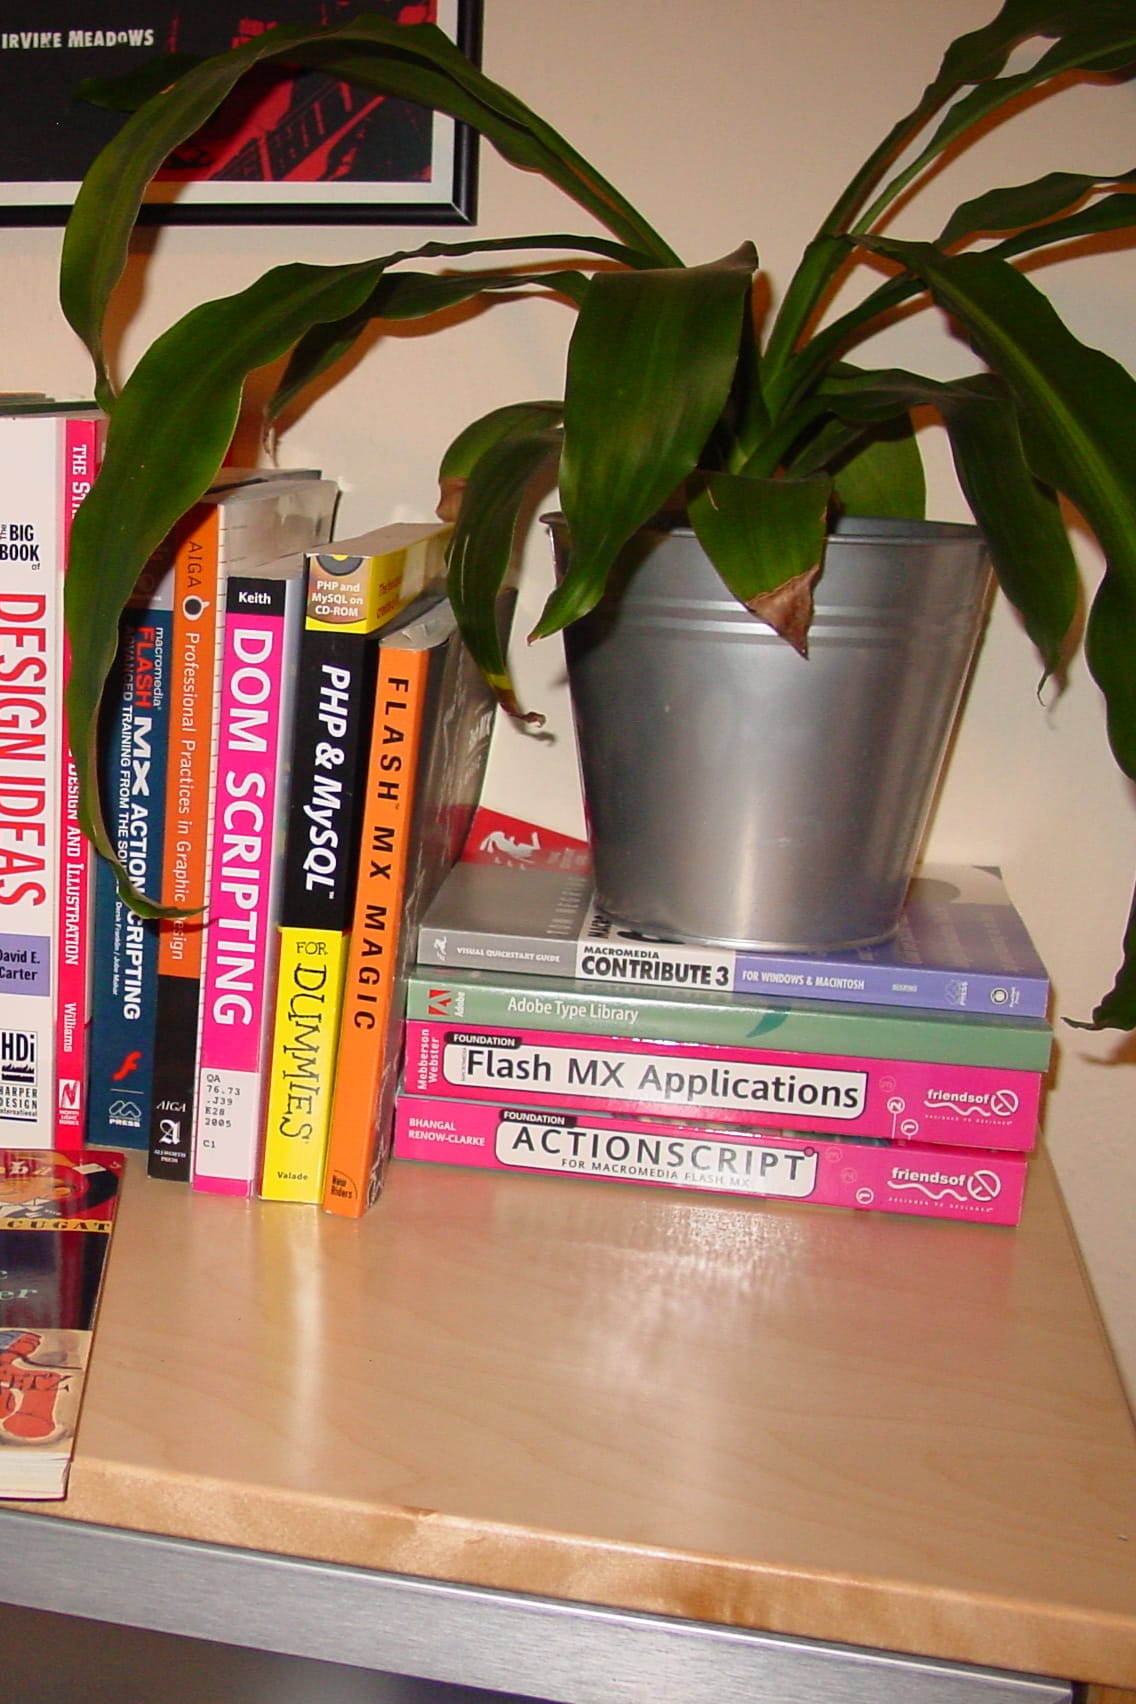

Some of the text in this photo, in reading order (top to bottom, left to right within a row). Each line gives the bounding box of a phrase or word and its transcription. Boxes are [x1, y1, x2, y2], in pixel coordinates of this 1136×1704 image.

[1, 32, 62, 49] IRVINE
[71, 444, 87, 475] THE
[0, 523, 8, 541] The
[9, 523, 35, 542] BIG
[0, 543, 40, 562] BOOK
[31, 562, 41, 571] of
[316, 580, 360, 593] PHP and
[238, 590, 271, 606] Keith
[312, 593, 364, 605] MySQL on
[315, 605, 359, 617] CD-ROM
[152, 627, 164, 707] macromedia
[119, 705, 133, 767] TRAINING
[169, 541, 202, 961] AIGA Professional Practices in Graphic esign
[302, 664, 351, 893] PHP & MySQL
[119, 769, 132, 808] FROM
[117, 811, 130, 839] THE
[123, 626, 155, 1020] FLASH MX ACTIONCRIPTING
[214, 628, 273, 1027] DOM SCRIPTING
[67, 825, 81, 857] AND
[354, 677, 409, 1031] FLASH MX MAGIC
[30, 951, 40, 964] E.
[296, 941, 328, 956] FOR
[583, 945, 660, 960] MACROMEDIA
[581, 957, 730, 987] CONTRIBUTE 3
[742, 970, 865, 990] FOR WINDOWS & MACINTOSH
[507, 997, 639, 1023] Adobe Type Library
[63, 1002, 77, 1053] Williams
[1, 1031, 35, 1062] HDi
[453, 1033, 516, 1047] FOUNDATION
[279, 962, 328, 1143] DUMMIES
[417, 1028, 430, 1091] Mebberson
[428, 1038, 440, 1084] Webster
[206, 1074, 221, 1083] QA
[467, 1049, 552, 1082] Flash
[567, 1057, 625, 1088] MX
[638, 1063, 859, 1110] Applications
[206, 1085, 241, 1096] 76.73
[927, 1088, 990, 1104] friendsof
[156, 1100, 187, 1113] AIGA
[205, 1118, 231, 1128] 2005
[409, 1117, 456, 1132] BHANGAL
[504, 1110, 565, 1126] FOUNDATION
[408, 1130, 485, 1147] RENOW-CLARKE
[512, 1125, 805, 1181] ACTIONSCRIPT
[277, 1170, 309, 1181] Valade
[561, 1158, 751, 1189] FOR MACROMEDIA FLASH MX
[891, 1167, 967, 1187] friendsof
[6, 1219, 111, 1232] CUGAT
